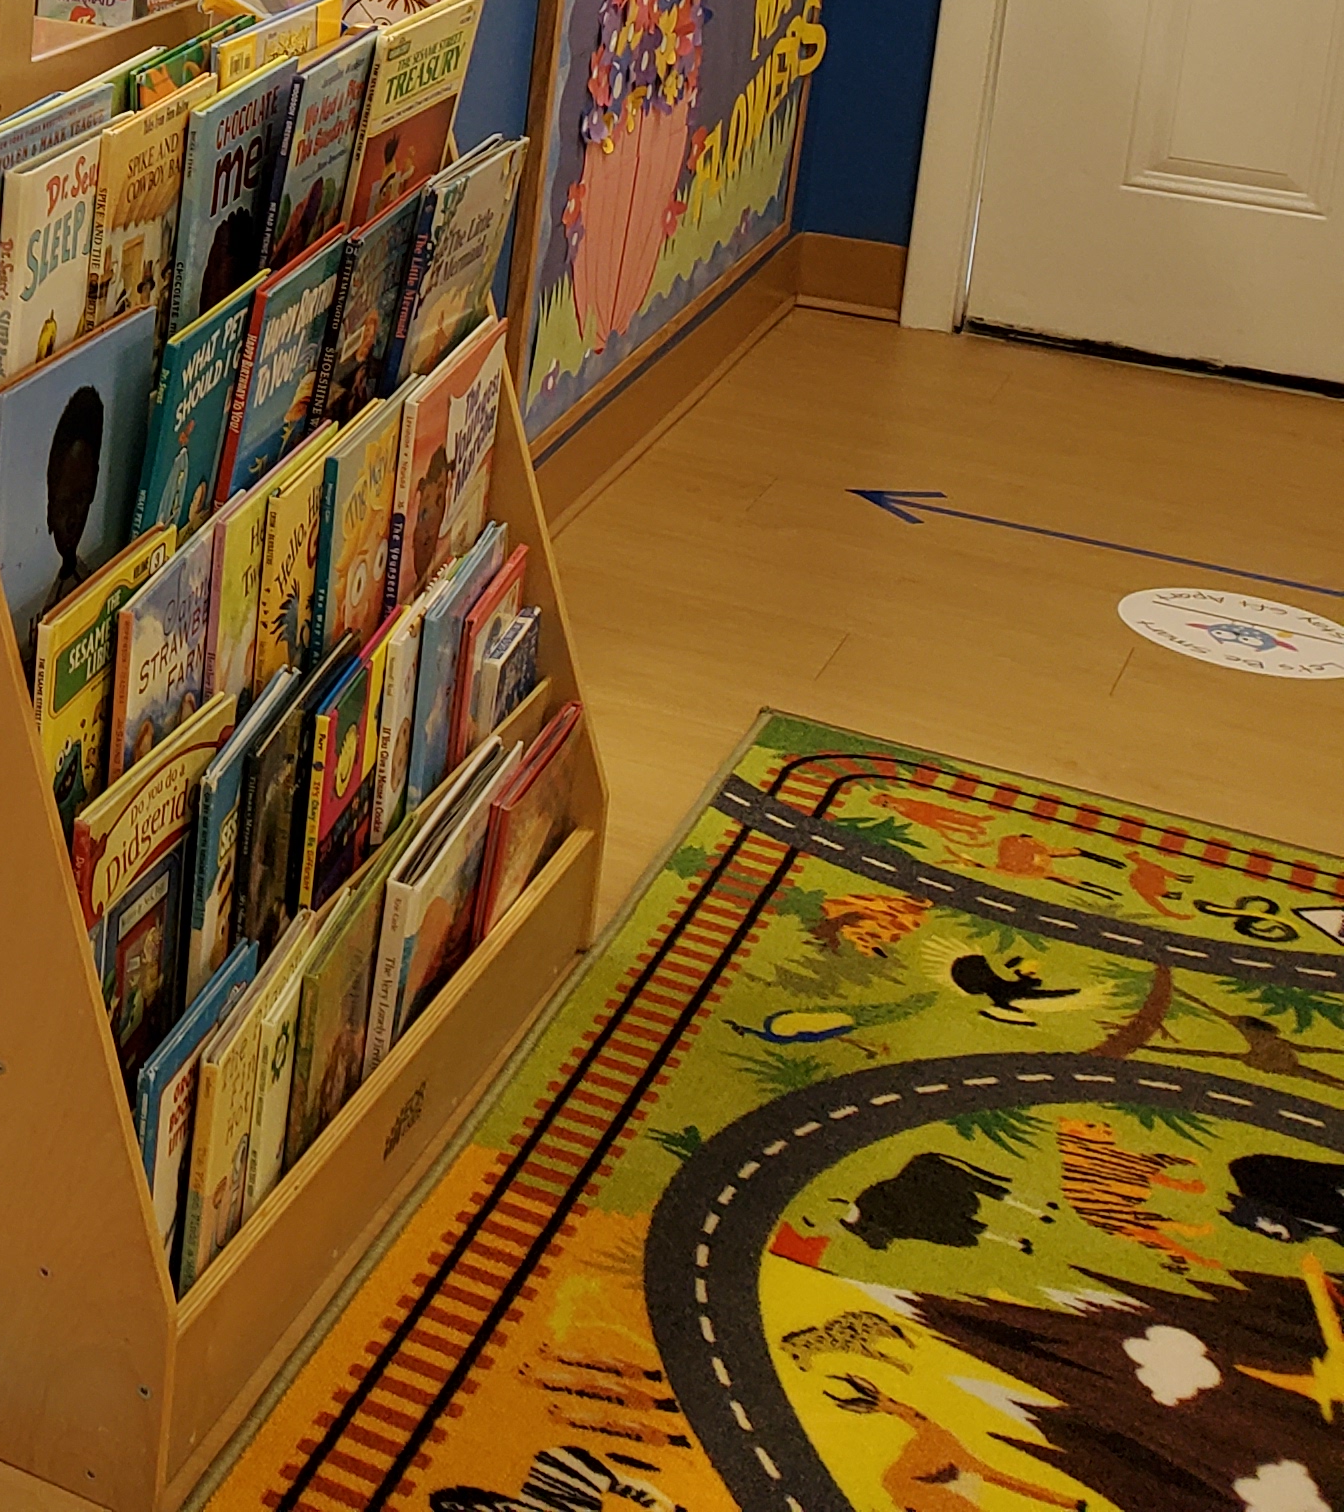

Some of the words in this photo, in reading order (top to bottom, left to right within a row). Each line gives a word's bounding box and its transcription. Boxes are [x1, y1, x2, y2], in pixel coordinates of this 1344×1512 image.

[385, 42, 465, 105] TREASURY
[39, 128, 66, 154] MARK
[69, 109, 105, 139] TEAGUE
[215, 85, 280, 150] CHOCOLATE
[127, 145, 154, 179] SPIKE
[158, 132, 179, 162] AND
[46, 175, 69, 217] Dr.
[71, 154, 100, 198] Seu
[98, 188, 108, 217] SPIKE
[126, 164, 165, 204] COWBOY
[19, 199, 87, 303] SLEEP
[95, 220, 106, 245] AND
[416, 234, 428, 255] The
[92, 246, 103, 273] THE
[408, 256, 421, 288] Little
[171, 261, 184, 318] CHOCOLATE
[259, 302, 297, 364] HAPPY
[295, 274, 338, 336] BIRTHD
[396, 288, 415, 339] Mermaid
[182, 328, 221, 389] WHAT
[222, 308, 249, 350] PET
[246, 333, 258, 360] HAPPY
[238, 359, 253, 399] BIRTHDAY
[253, 365, 270, 410] TO
[270, 329, 304, 390] YOU!
[313, 346, 336, 418] SHOESHINE
[174, 359, 222, 432] SHOULD
[224, 352, 231, 378] I
[106, 589, 121, 615] THE
[1155, 591, 1226, 605] Apart
[68, 619, 111, 674] SESAME
[139, 598, 209, 695] STRAWBE
[1137, 620, 1212, 655] Smart
[1224, 654, 1264, 670] Be
[37, 670, 45, 696] SESAME
[379, 751, 389, 767] Give
[130, 801, 144, 828] Do
[146, 779, 164, 812] you
[166, 767, 178, 790] do
[377, 775, 387, 799] Mouse
[373, 806, 384, 832] Cookie
[384, 957, 396, 977] The
[381, 978, 394, 1000] Very
[375, 1001, 391, 1035] Lonely
